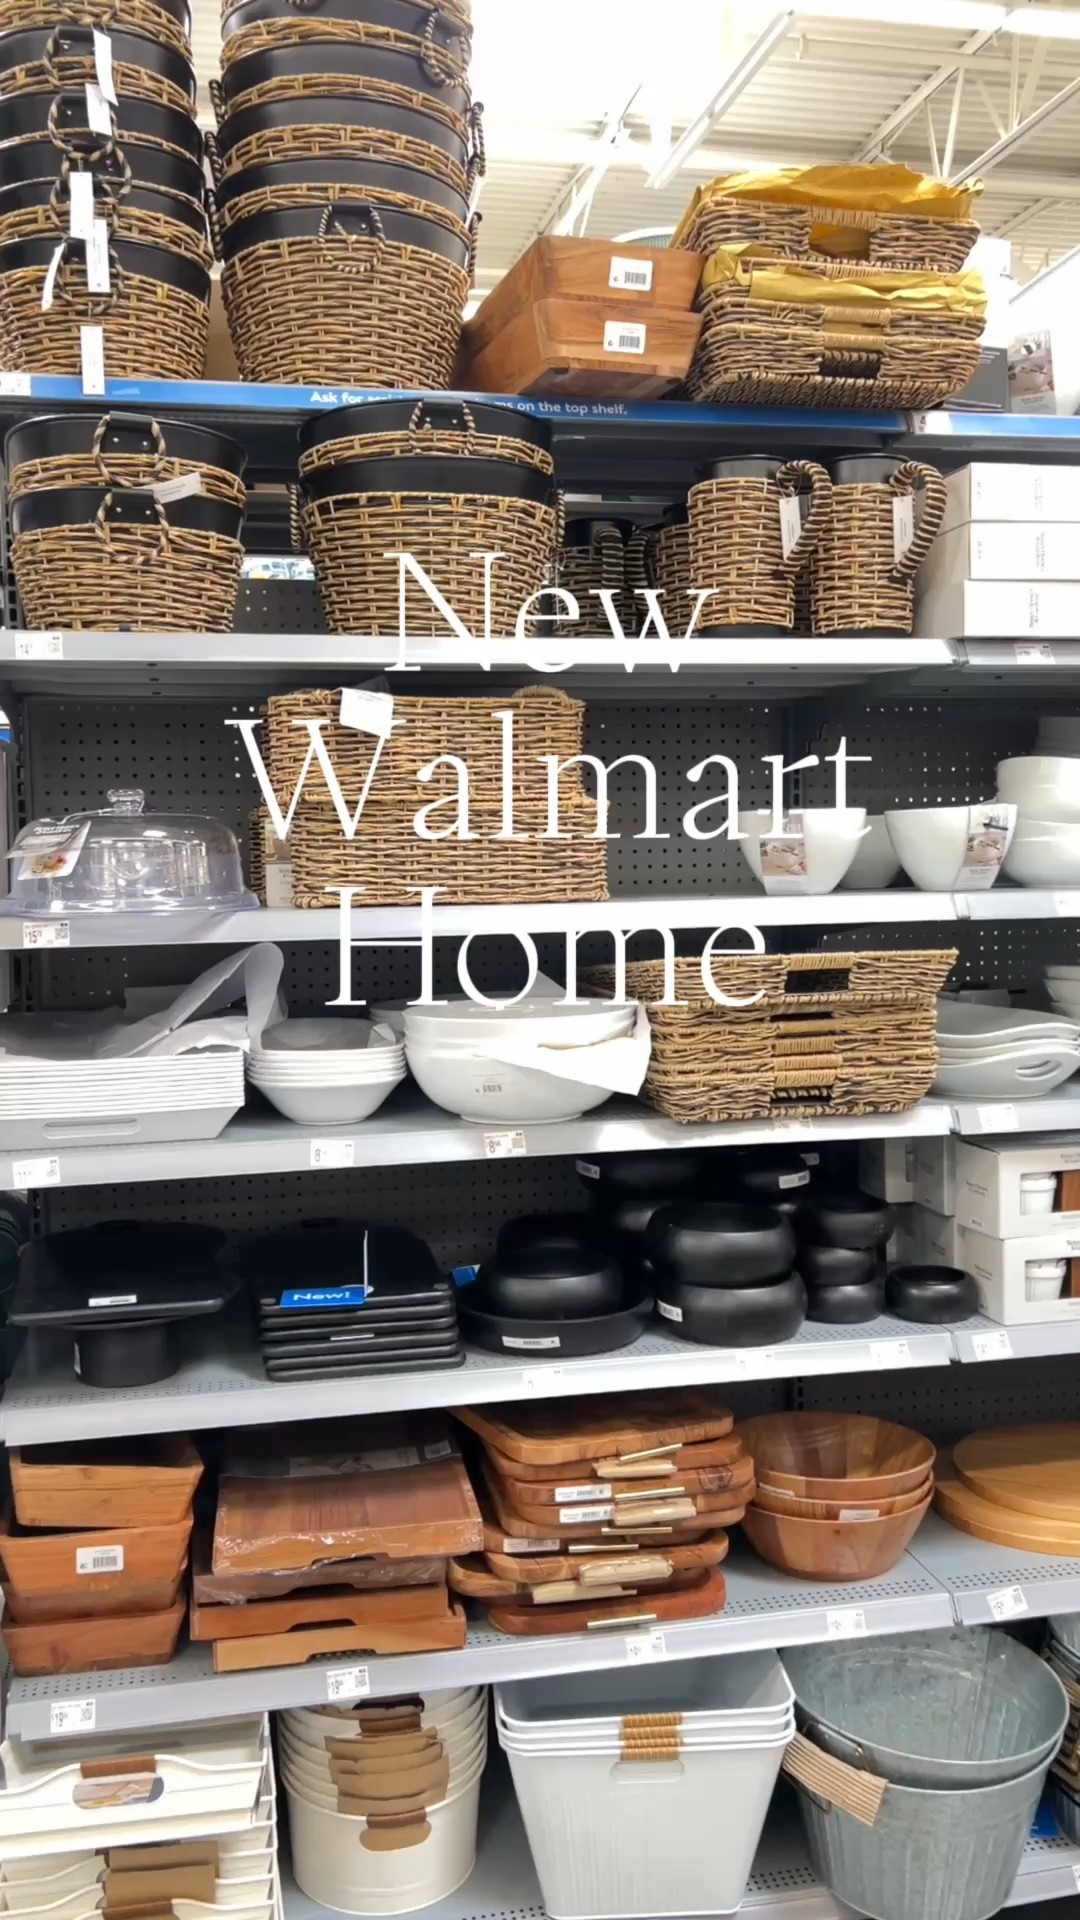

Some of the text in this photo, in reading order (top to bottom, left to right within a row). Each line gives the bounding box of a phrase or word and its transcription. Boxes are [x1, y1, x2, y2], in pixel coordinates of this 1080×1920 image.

[310, 391, 337, 403] Ask
[341, 392, 363, 404] for
[517, 403, 534, 411] on
[539, 401, 561, 413] the
[565, 403, 588, 416] top
[592, 403, 628, 415] shelf.
